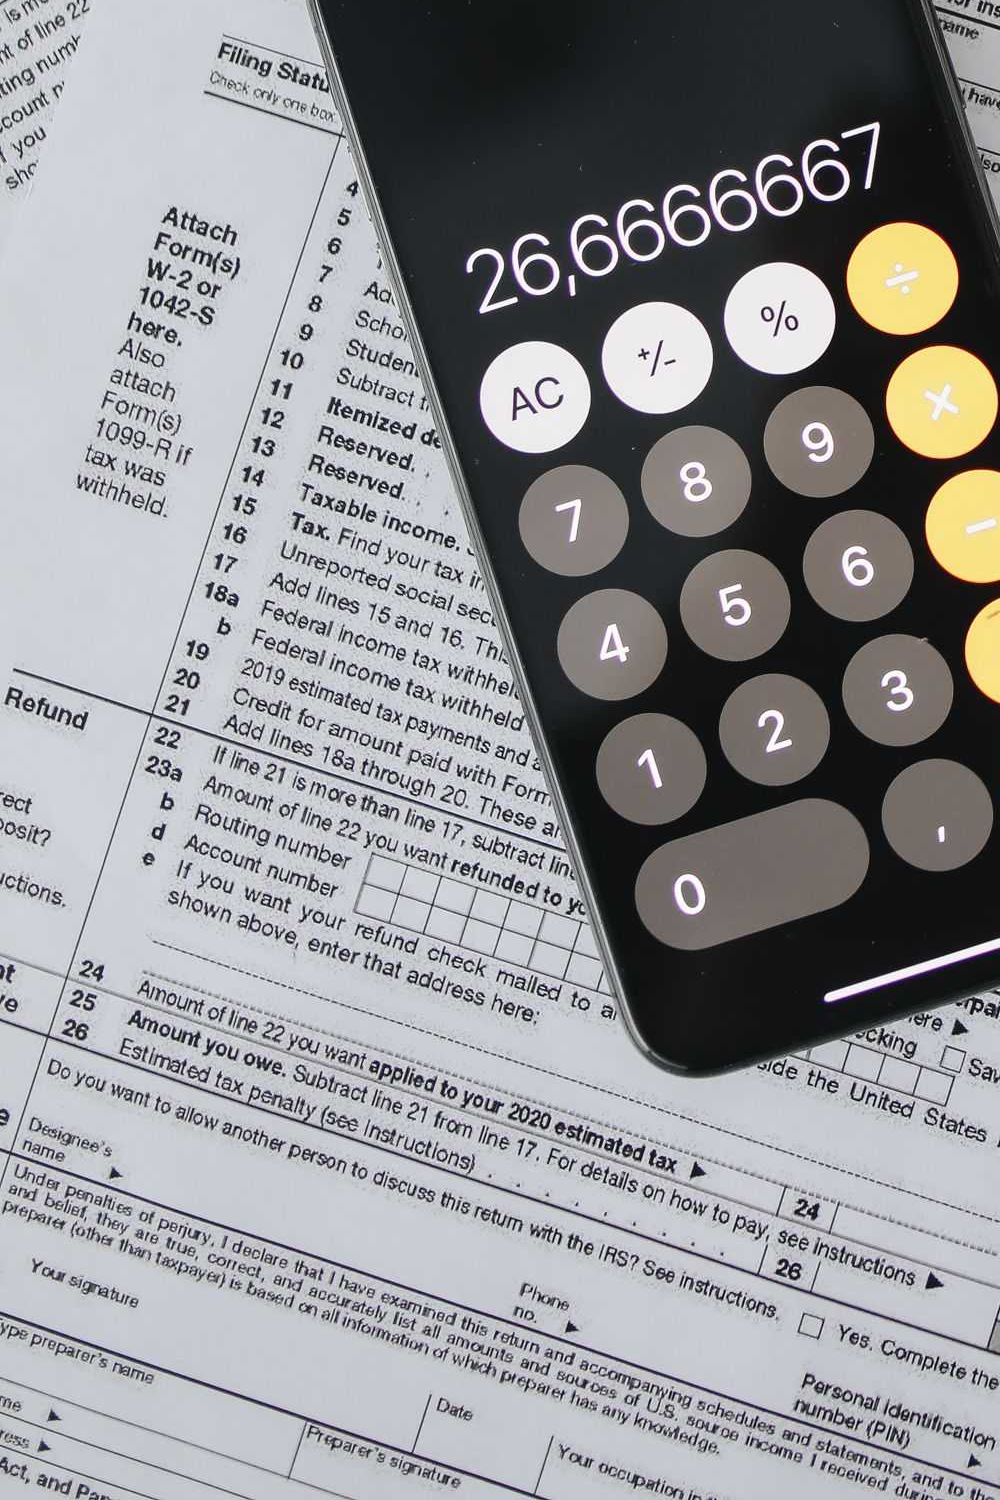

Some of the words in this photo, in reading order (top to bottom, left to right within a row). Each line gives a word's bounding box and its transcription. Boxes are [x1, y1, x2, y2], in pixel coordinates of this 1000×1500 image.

[217, 41, 273, 78] Filing
[161, 206, 238, 247] Attach
[465, 121, 881, 315] 26,6666667
[153, 231, 241, 281] Form(s)
[147, 257, 193, 291] W-2
[196, 280, 223, 299] or
[139, 286, 216, 327] 1042-S
[760, 300, 799, 338] %
[126, 310, 182, 347] here.
[117, 337, 166, 369] Also
[109, 368, 176, 403] attach
[511, 376, 564, 422] AC
[100, 389, 182, 437] Form(s)
[326, 396, 418, 441] Itemized
[96, 417, 173, 461] 1099-R
[175, 444, 194, 466] if
[317, 424, 415, 473] Reserved.
[801, 421, 835, 463] 9
[84, 444, 118, 472] tax
[124, 460, 167, 487] was
[679, 461, 713, 503] 8
[76, 473, 168, 518] withheld.
[555, 498, 582, 543] 7
[841, 545, 875, 587] 6
[204, 581, 240, 608] 18a
[718, 583, 752, 627] 5
[599, 623, 630, 663] 4
[4, 686, 89, 731] Refund
[880, 669, 914, 712] 3
[757, 709, 793, 753] 2
[637, 748, 663, 789] 1
[194, 803, 272, 848] Routing
[274, 833, 353, 870] number
[183, 833, 263, 874] Account
[266, 864, 339, 899] number
[673, 873, 706, 916] 0
[368, 1059, 438, 1094] applied
[439, 1079, 459, 1100] to
[459, 1090, 505, 1115] your
[507, 1101, 552, 1131] 2020
[553, 1121, 647, 1163] estimated
[648, 1148, 678, 1174] tax
[839, 1323, 873, 1352] Yes.
[880, 1339, 967, 1380] Complete
[971, 1367, 1000, 1391] the
[436, 1397, 474, 1422] Date
[801, 1372, 881, 1413] Personal
[792, 1398, 864, 1432] number
[865, 1419, 911, 1451] (PIN)
